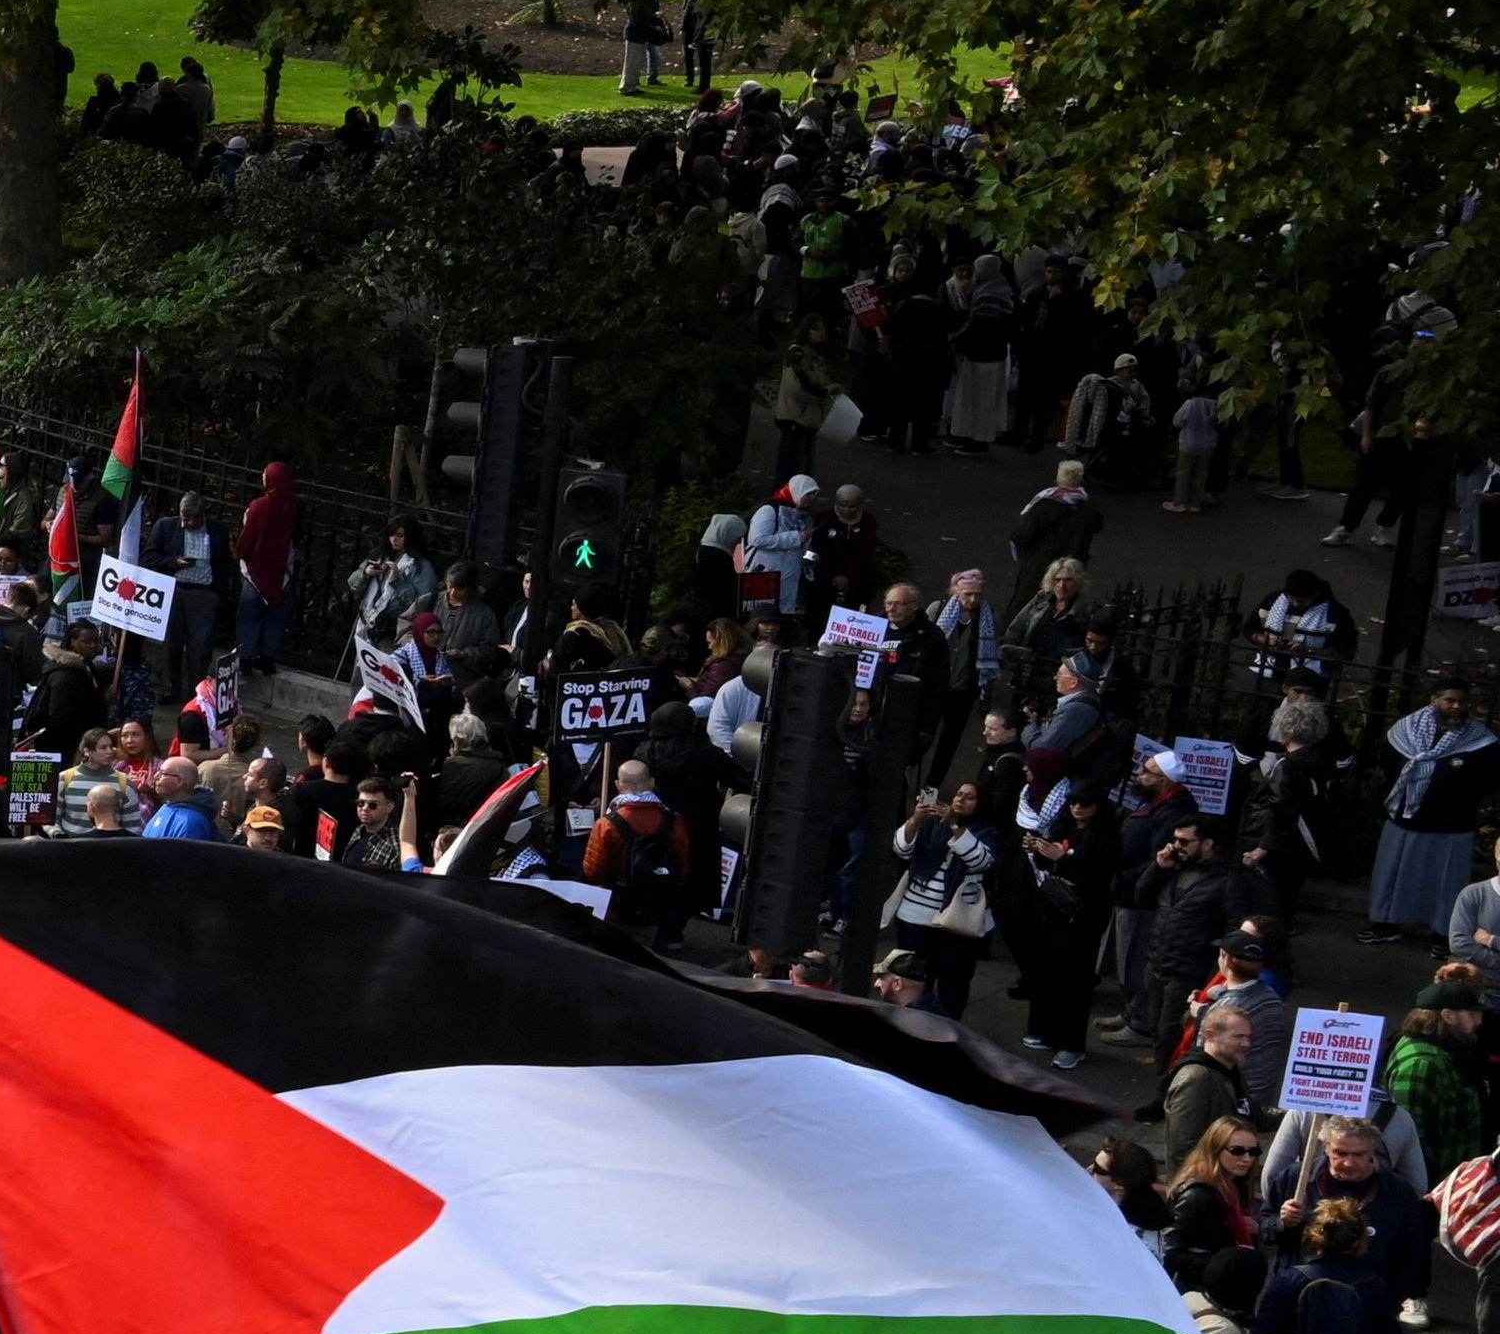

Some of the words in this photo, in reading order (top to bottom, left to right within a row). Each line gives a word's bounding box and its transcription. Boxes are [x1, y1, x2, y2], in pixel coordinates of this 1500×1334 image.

[563, 681, 595, 697] Stop
[599, 677, 650, 693] Starving
[561, 693, 646, 731] GAZA
[1300, 1030, 1324, 1047] END
[1327, 1034, 1373, 1051] ISRAELI
[1296, 1047, 1327, 1061] STATE
[1331, 1050, 1371, 1065] TERROR
